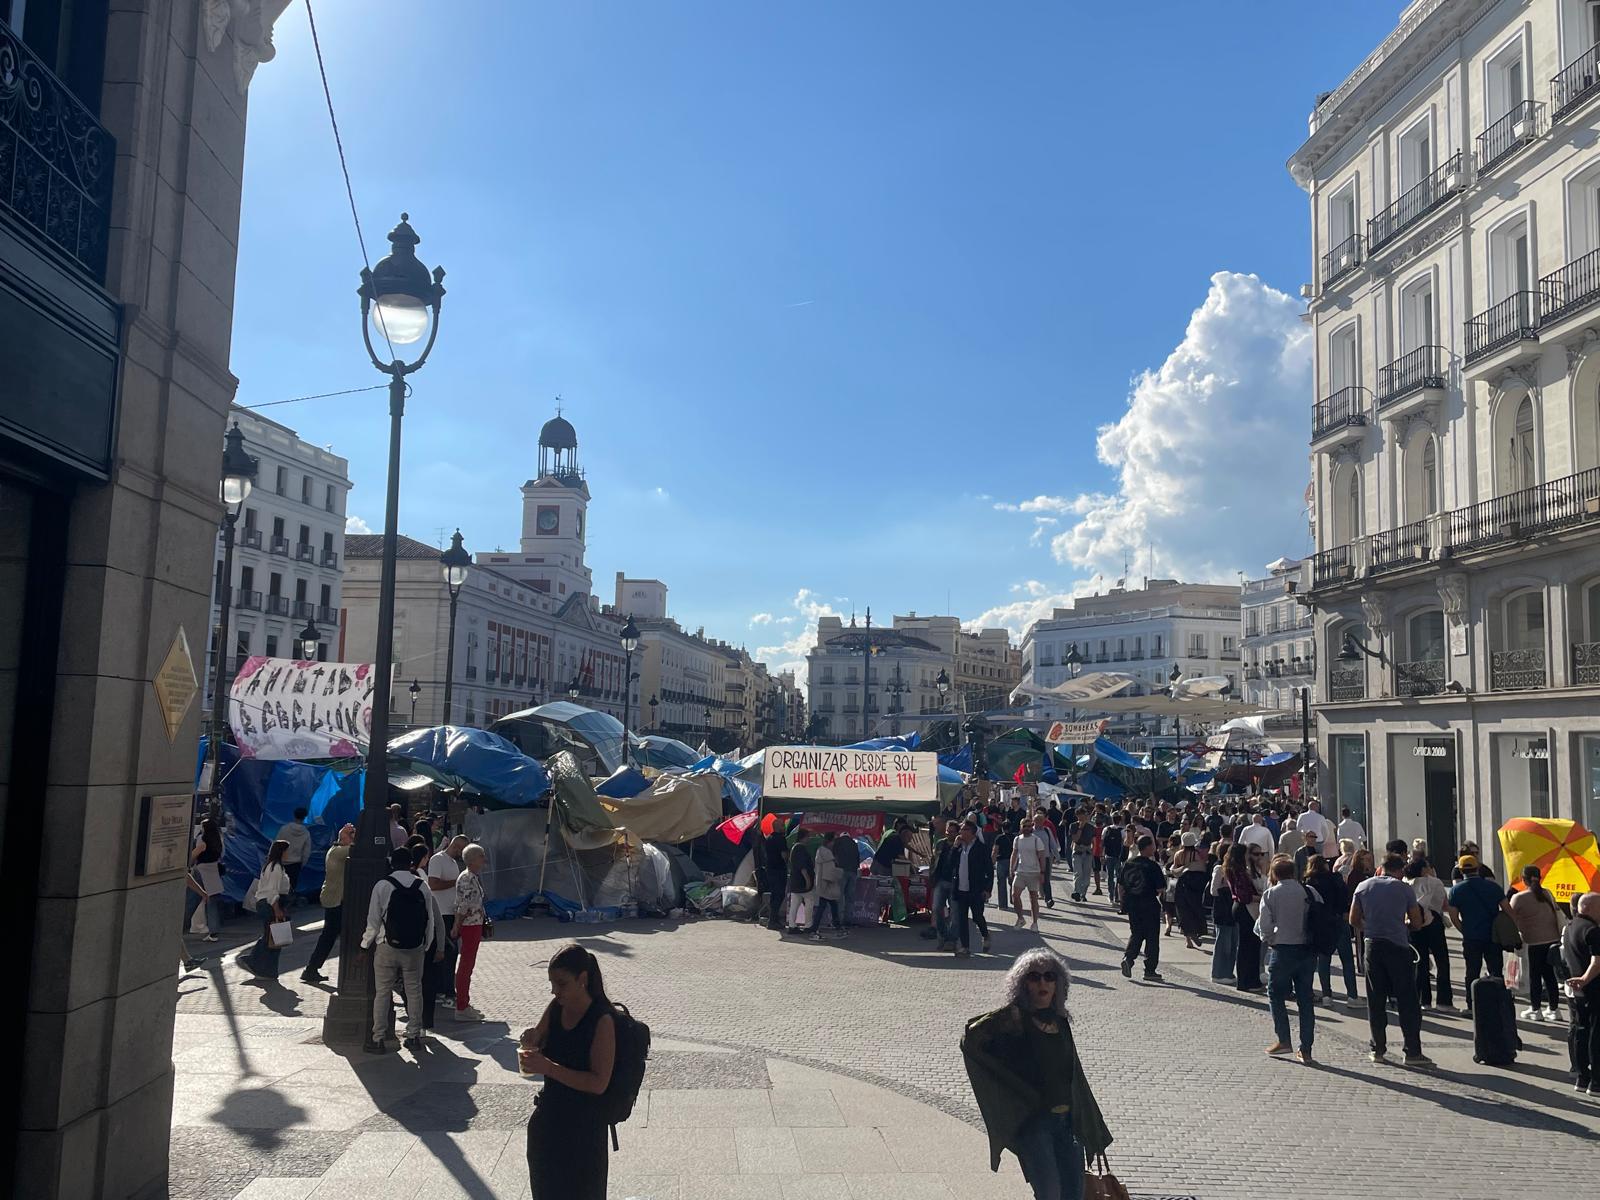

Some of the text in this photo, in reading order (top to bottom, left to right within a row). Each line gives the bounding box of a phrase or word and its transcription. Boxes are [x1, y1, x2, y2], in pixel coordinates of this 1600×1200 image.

[771, 750, 918, 772] ORGANIZAR DESDE SOL
[772, 772, 916, 789] LA HUELGA GENERAL 11N
